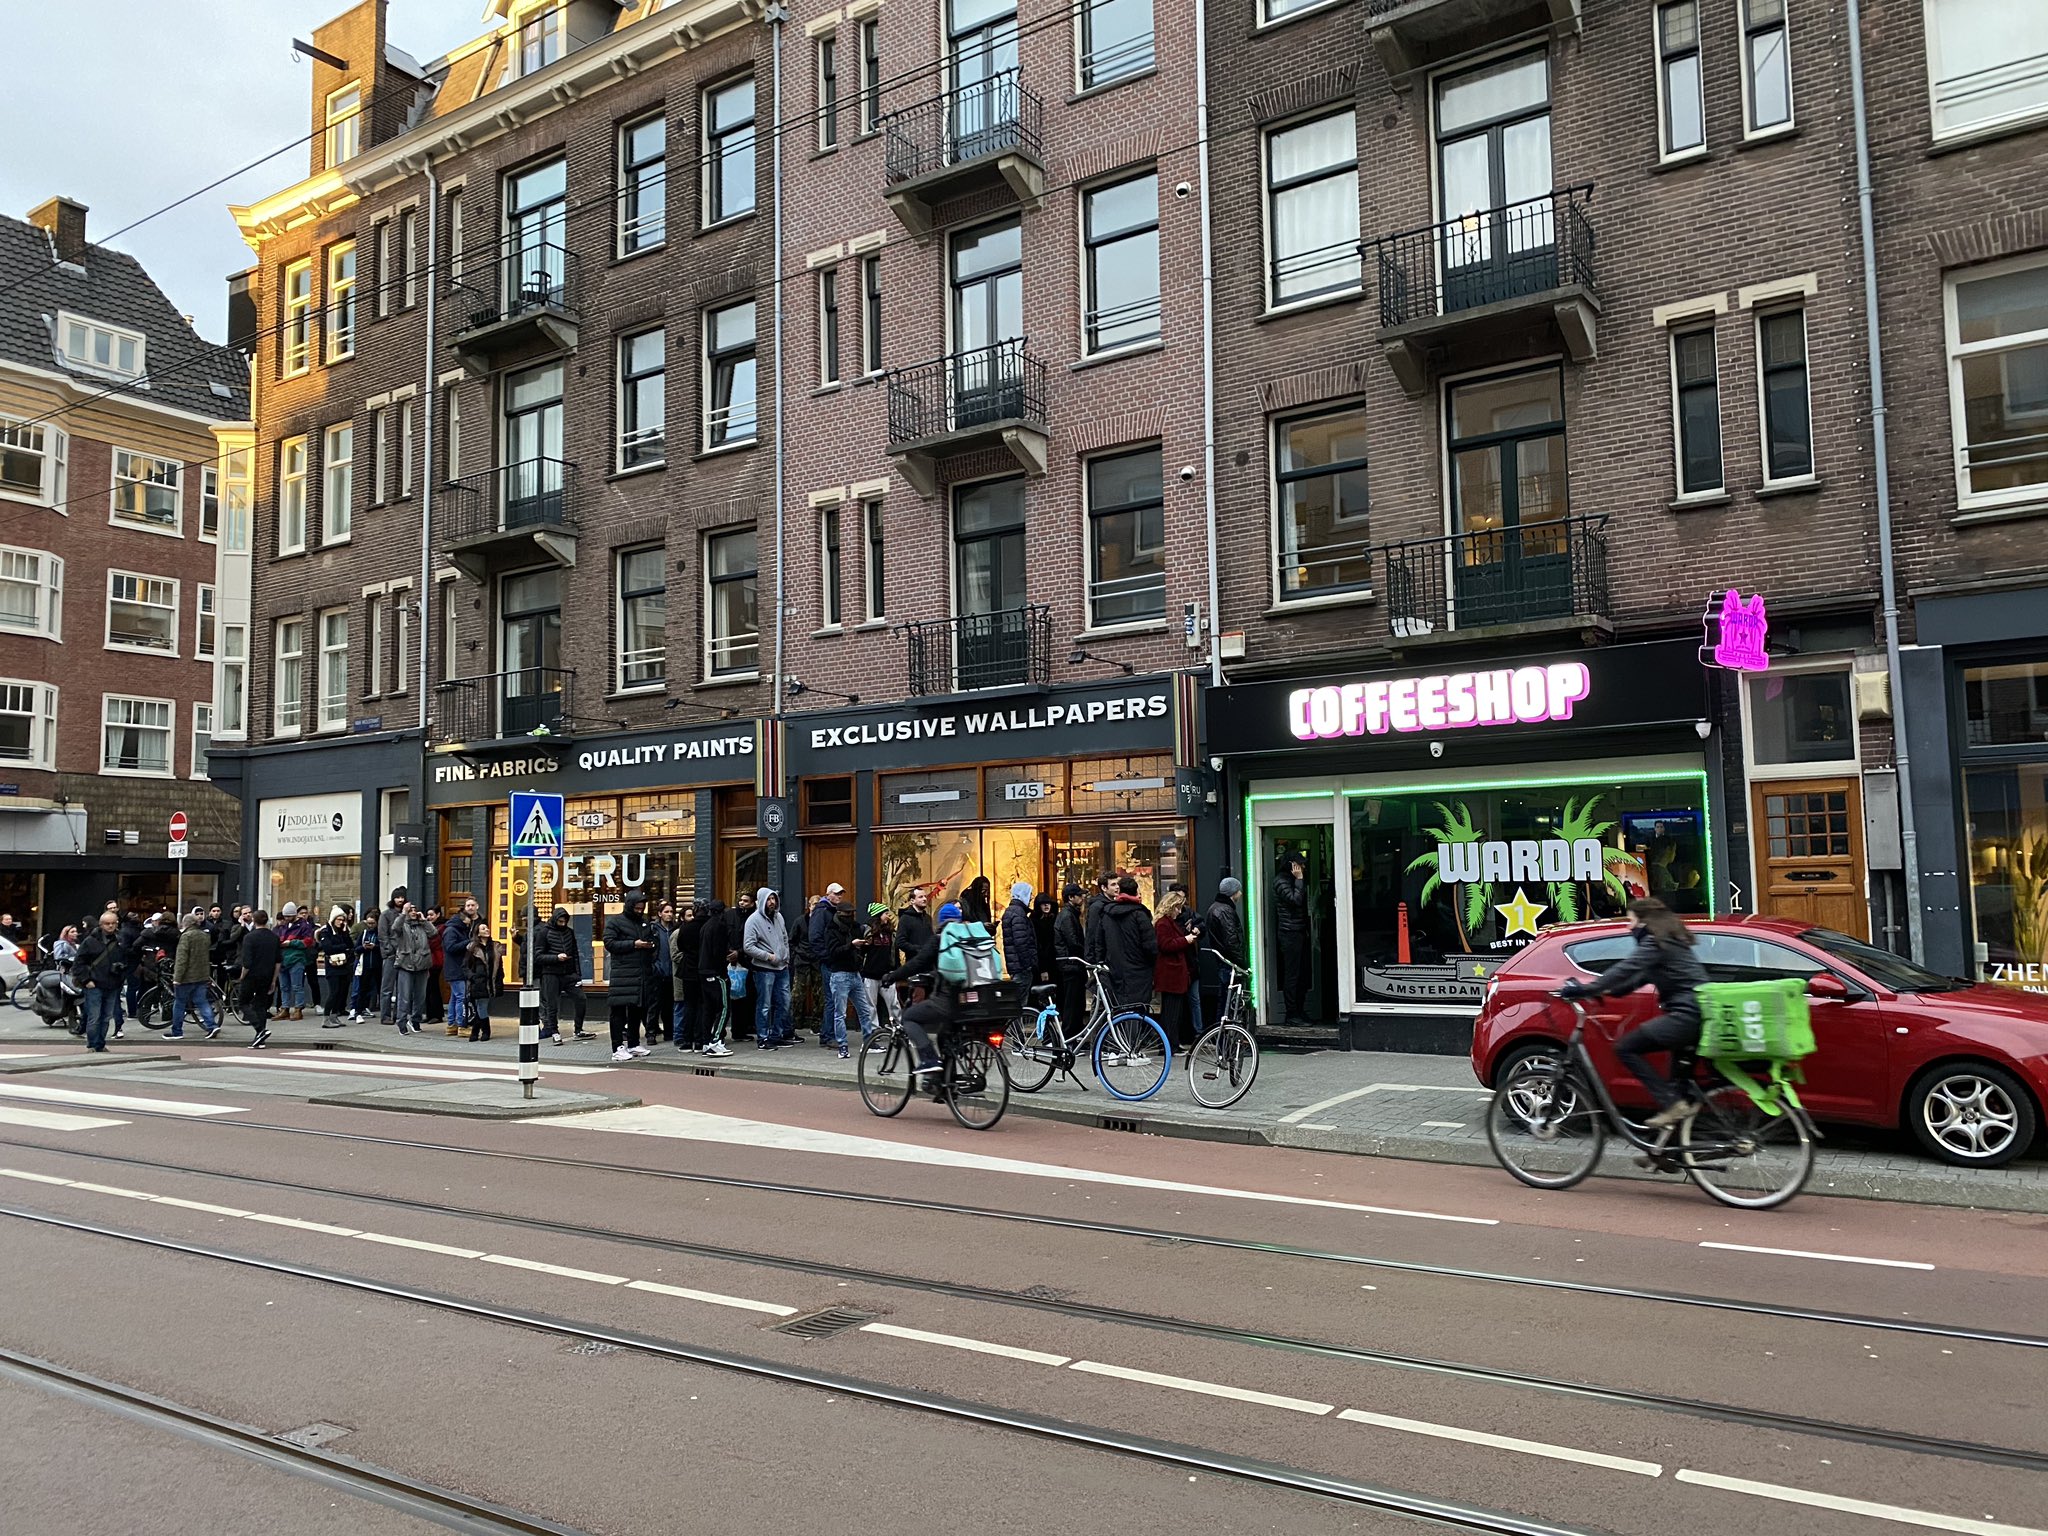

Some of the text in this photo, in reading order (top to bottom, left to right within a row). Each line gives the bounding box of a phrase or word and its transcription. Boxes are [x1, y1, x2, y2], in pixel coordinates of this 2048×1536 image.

[1289, 662, 1591, 740] COFFEESHOP
[811, 695, 1168, 748] EXCLUSIVE WALLPAPERS
[578, 736, 754, 771] QUALITY PAINTS
[435, 757, 559, 783] FINE FABRICS
[1011, 784, 1038, 798] 145
[581, 814, 600, 826] 143
[1438, 838, 1603, 883] WARDA
[1513, 905, 1525, 927] 1
[1489, 939, 1513, 950] BEST
[1515, 939, 1527, 947] IN
[1386, 983, 1481, 995] AMSTERDAM
